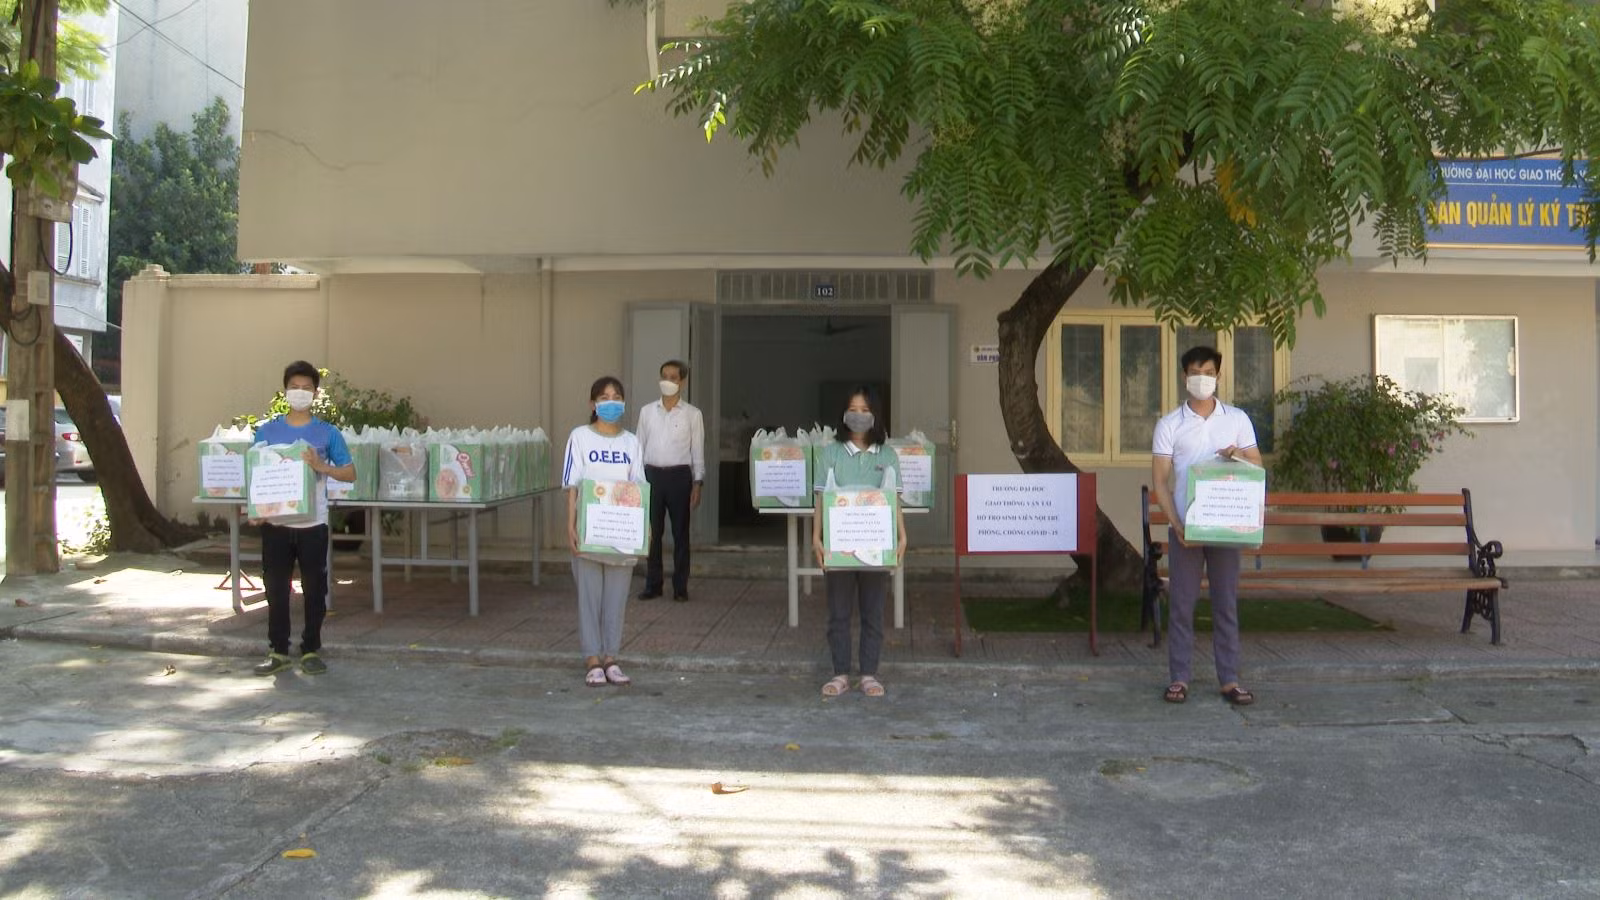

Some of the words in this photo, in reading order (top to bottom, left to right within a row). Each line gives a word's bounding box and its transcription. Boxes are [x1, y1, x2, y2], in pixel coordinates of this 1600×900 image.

[1440, 162, 1472, 180] RƯỜNG
[1475, 168, 1492, 182] ĐẠI
[1495, 168, 1516, 183] HỌC
[1519, 169, 1543, 180] GIAO
[1545, 166, 1579, 181] THÔ
[1466, 193, 1512, 228] QUẢN
[1518, 198, 1535, 226] LÝ
[1539, 198, 1561, 227] KÝ
[817, 287, 833, 296] 102
